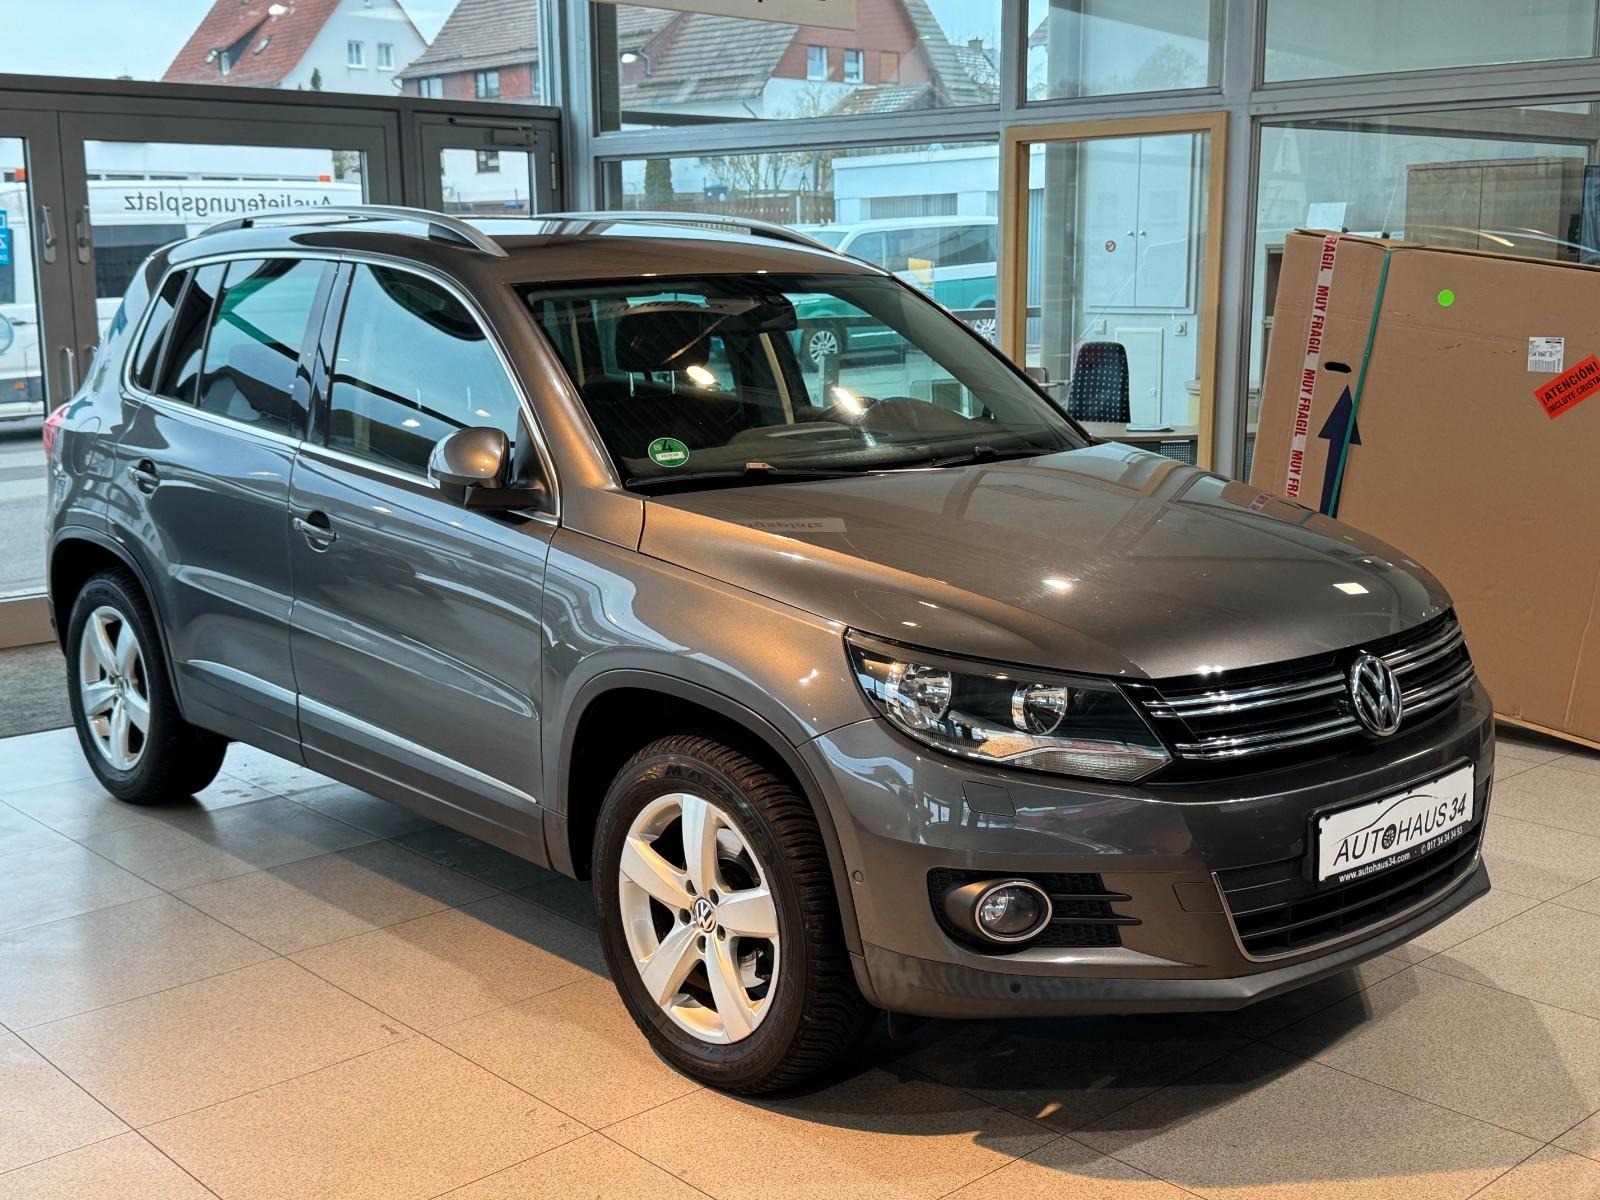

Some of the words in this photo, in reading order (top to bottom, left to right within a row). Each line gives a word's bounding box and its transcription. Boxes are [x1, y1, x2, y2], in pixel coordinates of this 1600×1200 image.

[1315, 285, 1330, 312] MUY
[1307, 314, 1325, 355] FRAGIL
[1301, 368, 1316, 395] MUY
[1541, 361, 1600, 406] ¡ATENCIÓN!
[1547, 390, 1577, 413] INCLUYE
[1294, 397, 1311, 437] FRAGIL
[662, 439, 674, 453] 4
[1289, 449, 1304, 476] MUY
[1333, 802, 1448, 866] AUTOHAUS
[1449, 793, 1467, 822] 34
[1338, 851, 1411, 883] www.autohaus34.com
